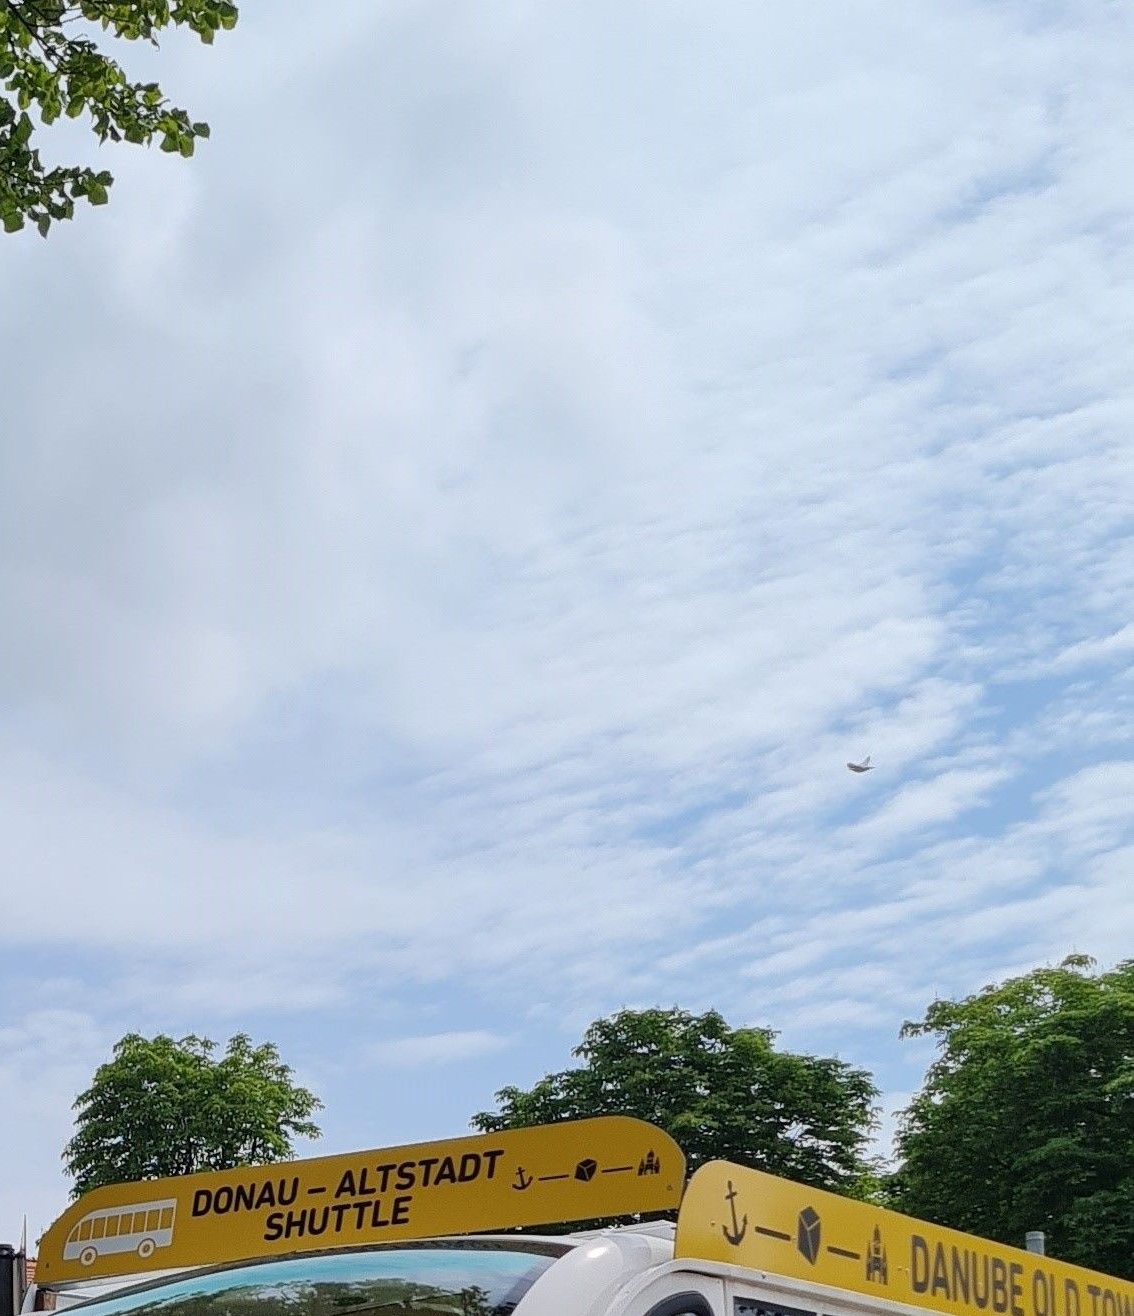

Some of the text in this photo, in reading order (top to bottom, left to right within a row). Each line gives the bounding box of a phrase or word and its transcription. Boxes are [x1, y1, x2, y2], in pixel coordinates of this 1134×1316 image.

[191, 1176, 299, 1217] DONAU
[334, 1150, 504, 1197] ALTSTADT
[264, 1195, 410, 1241] SHUTTLE
